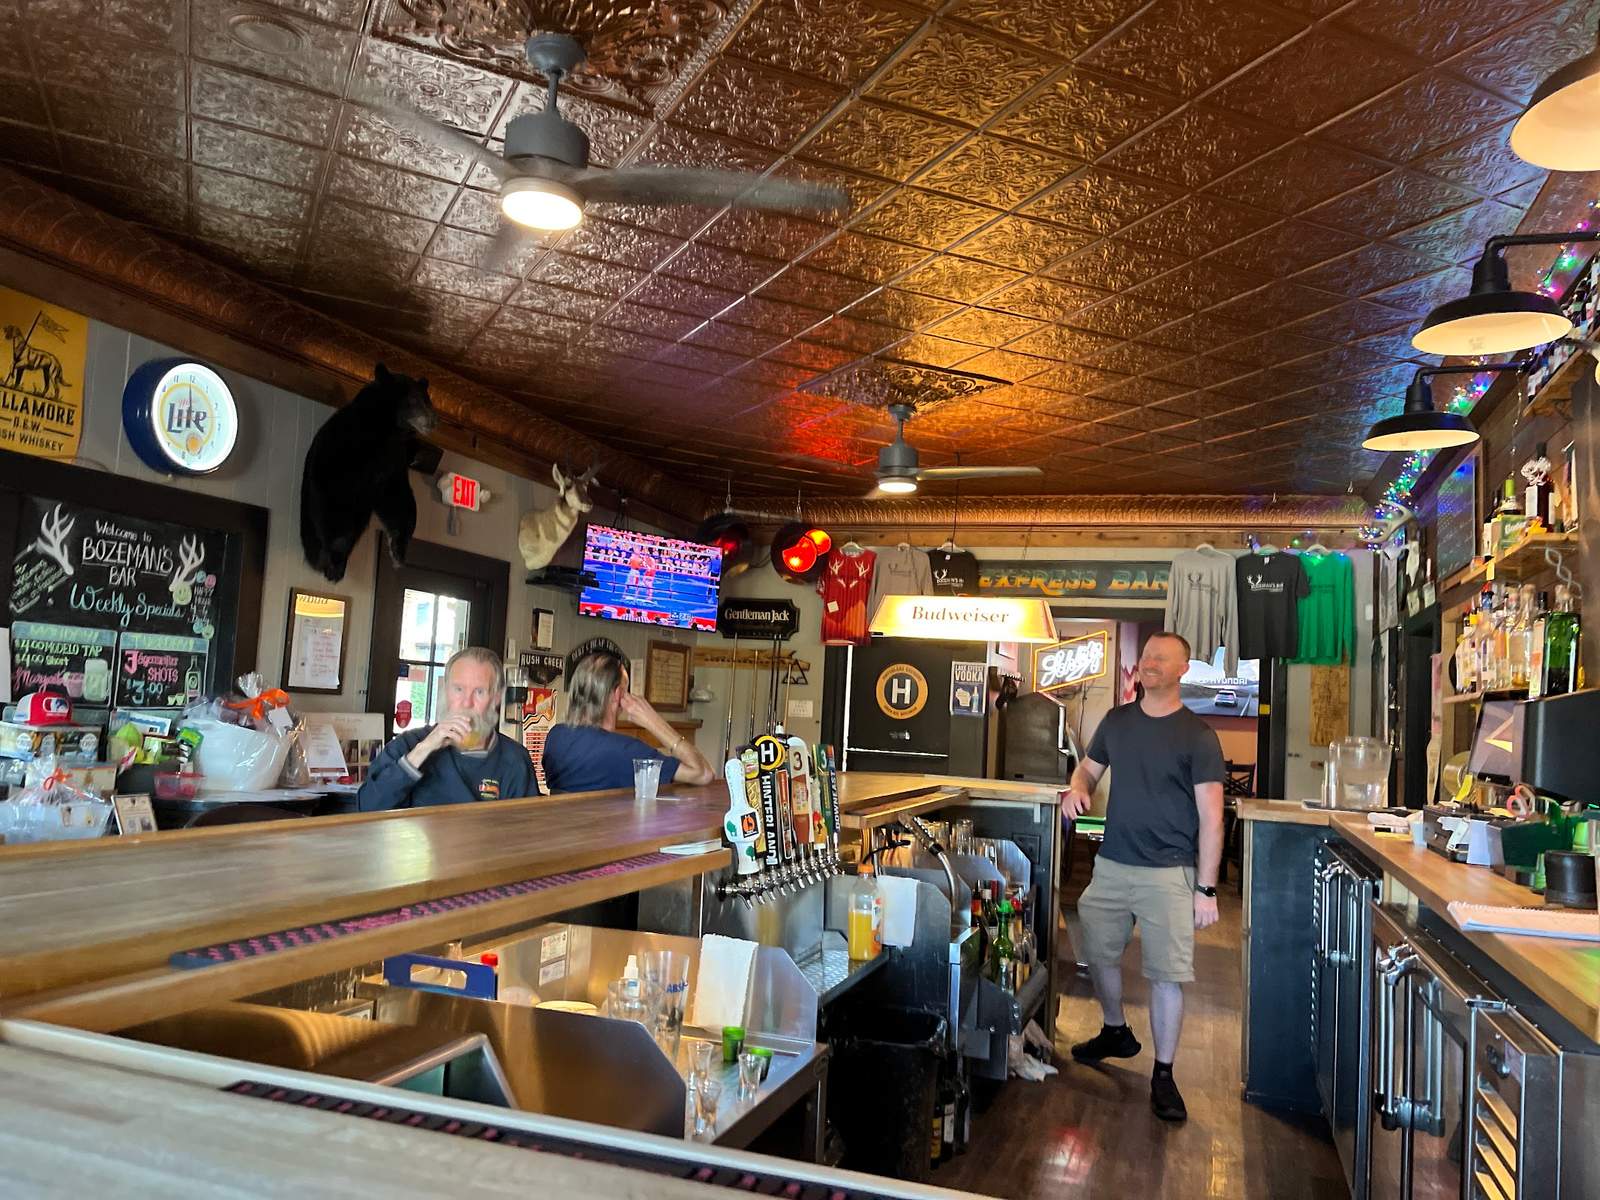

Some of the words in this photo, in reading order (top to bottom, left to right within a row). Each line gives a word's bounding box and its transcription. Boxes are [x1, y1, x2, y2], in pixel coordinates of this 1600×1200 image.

[167, 402, 207, 433] Lite
[20, 433, 64, 451] WHISKEY
[454, 475, 476, 508] EXIT
[95, 519, 138, 541] Welcome
[143, 530, 153, 543] to
[82, 536, 174, 573] BOZEMAN'S
[109, 565, 137, 587] BAR
[978, 568, 1098, 596] EXPRESS
[70, 582, 135, 628] Weekly
[135, 592, 184, 621] Specials
[724, 608, 771, 621] Gentleman
[771, 609, 790, 623] Jack
[912, 605, 1009, 623] Budweiser
[82, 644, 103, 657] TAP
[520, 653, 540, 666] RUSH
[147, 667, 179, 683] SHOTS
[955, 670, 983, 683] VODKA
[1211, 677, 1248, 685] HYUNDAI
[891, 678, 911, 704] H
[760, 742, 775, 763] H
